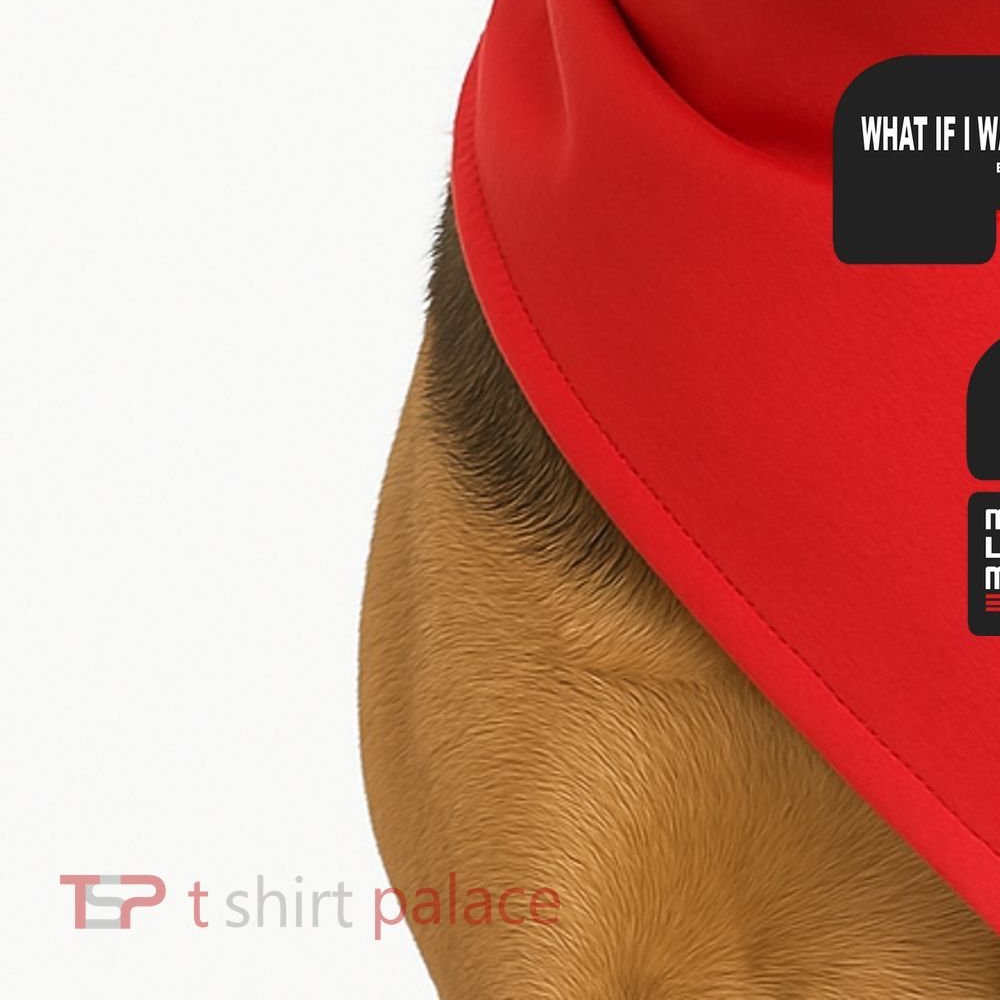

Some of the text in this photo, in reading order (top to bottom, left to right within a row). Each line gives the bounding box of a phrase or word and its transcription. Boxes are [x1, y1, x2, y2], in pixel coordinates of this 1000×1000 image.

[861, 115, 928, 151] WHAT
[935, 115, 956, 151] IF
[964, 115, 970, 151] I
